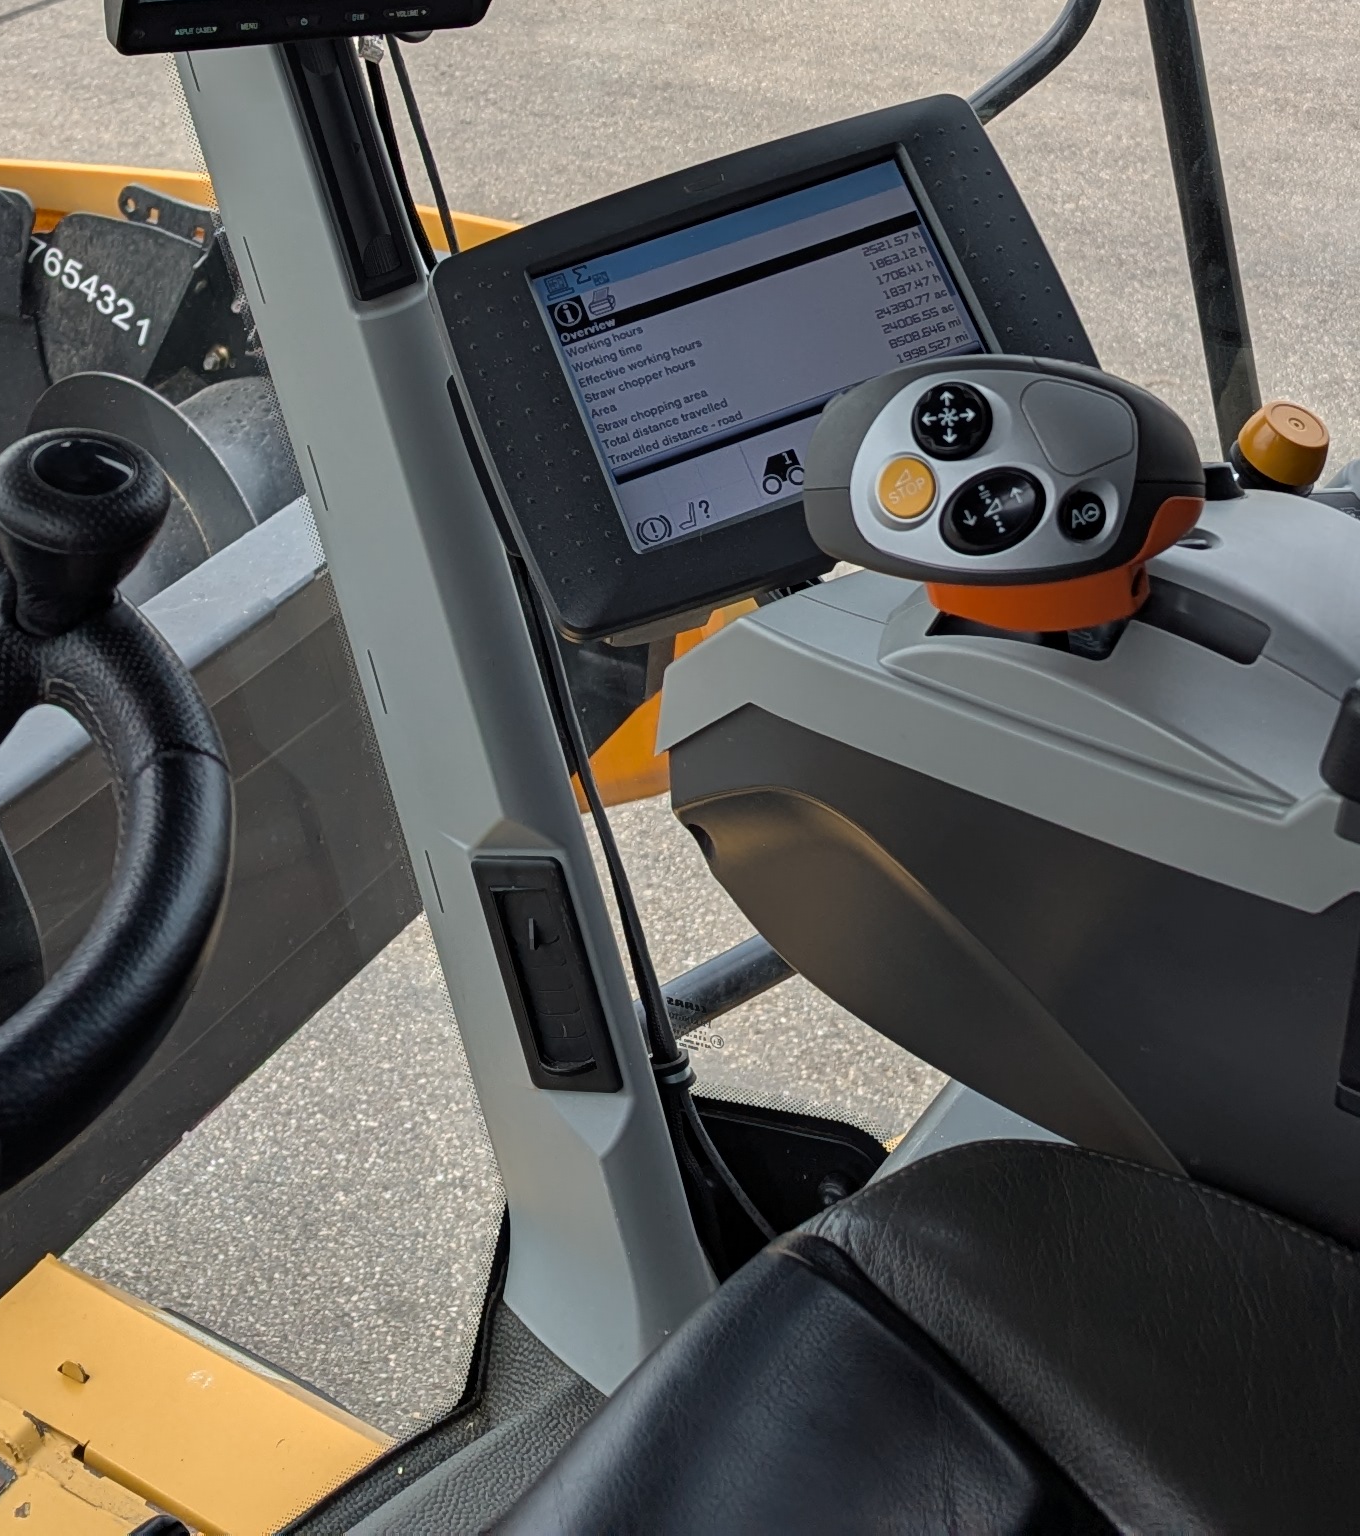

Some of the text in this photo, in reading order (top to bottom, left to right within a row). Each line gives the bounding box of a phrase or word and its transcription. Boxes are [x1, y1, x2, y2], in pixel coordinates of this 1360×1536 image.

[240, 22, 258, 31] MENU
[862, 231, 921, 257] 2521.57 h
[869, 245, 928, 271] 1863.12 h
[876, 259, 935, 286] 1706.41 h
[28, 236, 151, 346] 7654321
[883, 273, 942, 300] 1837.47 h
[934, 289, 948, 299] ac
[560, 318, 616, 343] Overview
[881, 303, 955, 334] 24006.55 ac
[948, 316, 962, 329] mi
[565, 326, 644, 358] Working hours
[955, 331, 969, 344] mi
[571, 342, 643, 374] Working time
[578, 338, 702, 389] Effective working hours
[584, 358, 696, 404] Straw chopper hours
[591, 403, 618, 419] Area
[596, 389, 708, 434] Straw chopping area
[602, 397, 728, 450] Total distance travelled
[608, 439, 660, 465] Travelled
[662, 422, 708, 447] distance
[717, 410, 743, 428] road
[781, 452, 792, 465] 1
[888, 475, 926, 505] STOP
